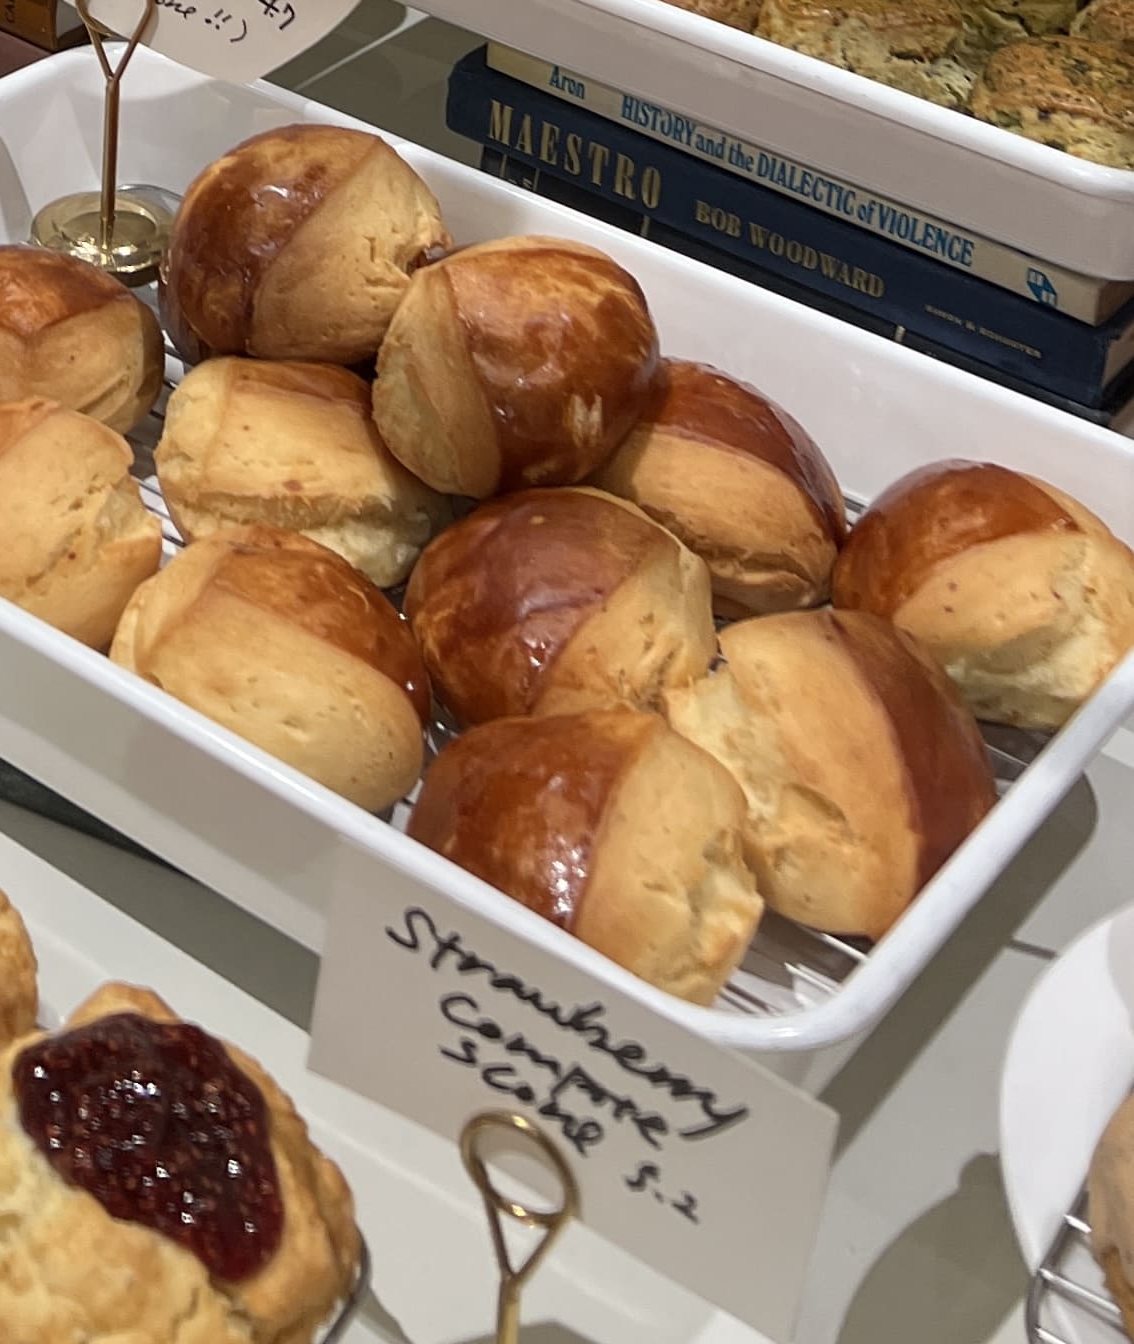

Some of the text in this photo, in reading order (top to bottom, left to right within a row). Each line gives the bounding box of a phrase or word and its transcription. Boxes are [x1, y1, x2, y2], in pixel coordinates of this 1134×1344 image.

[488, 98, 886, 299] MAESTRO BOB WOODWARD
[549, 65, 975, 269] Aron HISTORY and the DIALECTIC of VIOLENCE
[385, 905, 750, 1139] Strawberry
